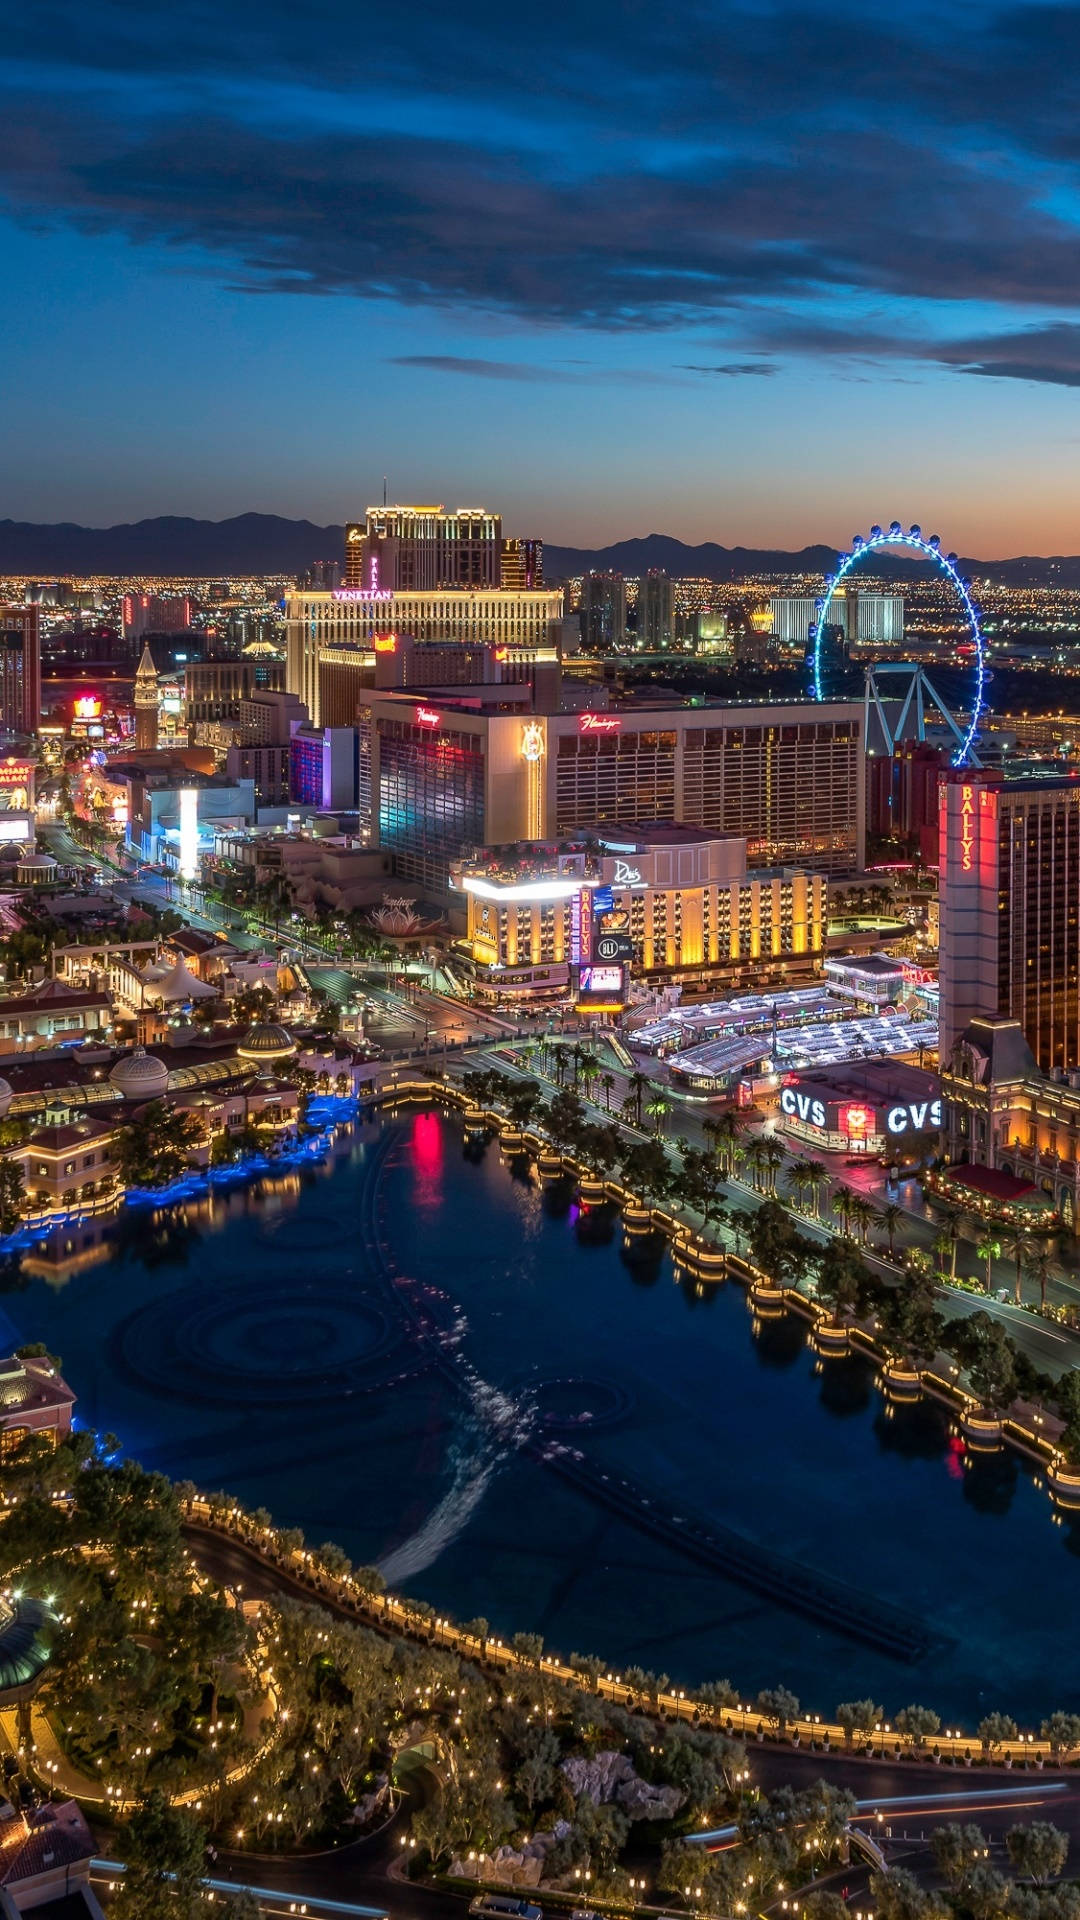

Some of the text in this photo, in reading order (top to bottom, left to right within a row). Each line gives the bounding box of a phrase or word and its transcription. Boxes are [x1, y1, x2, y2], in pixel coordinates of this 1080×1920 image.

[333, 591, 391, 600] VENETIAN
[580, 714, 621, 730] Flamingo
[961, 786, 975, 870] BALLYS
[581, 892, 590, 955] BALLYS
[602, 943, 614, 955] BLT
[782, 1089, 825, 1127] CVS
[888, 1100, 941, 1133] CVS
